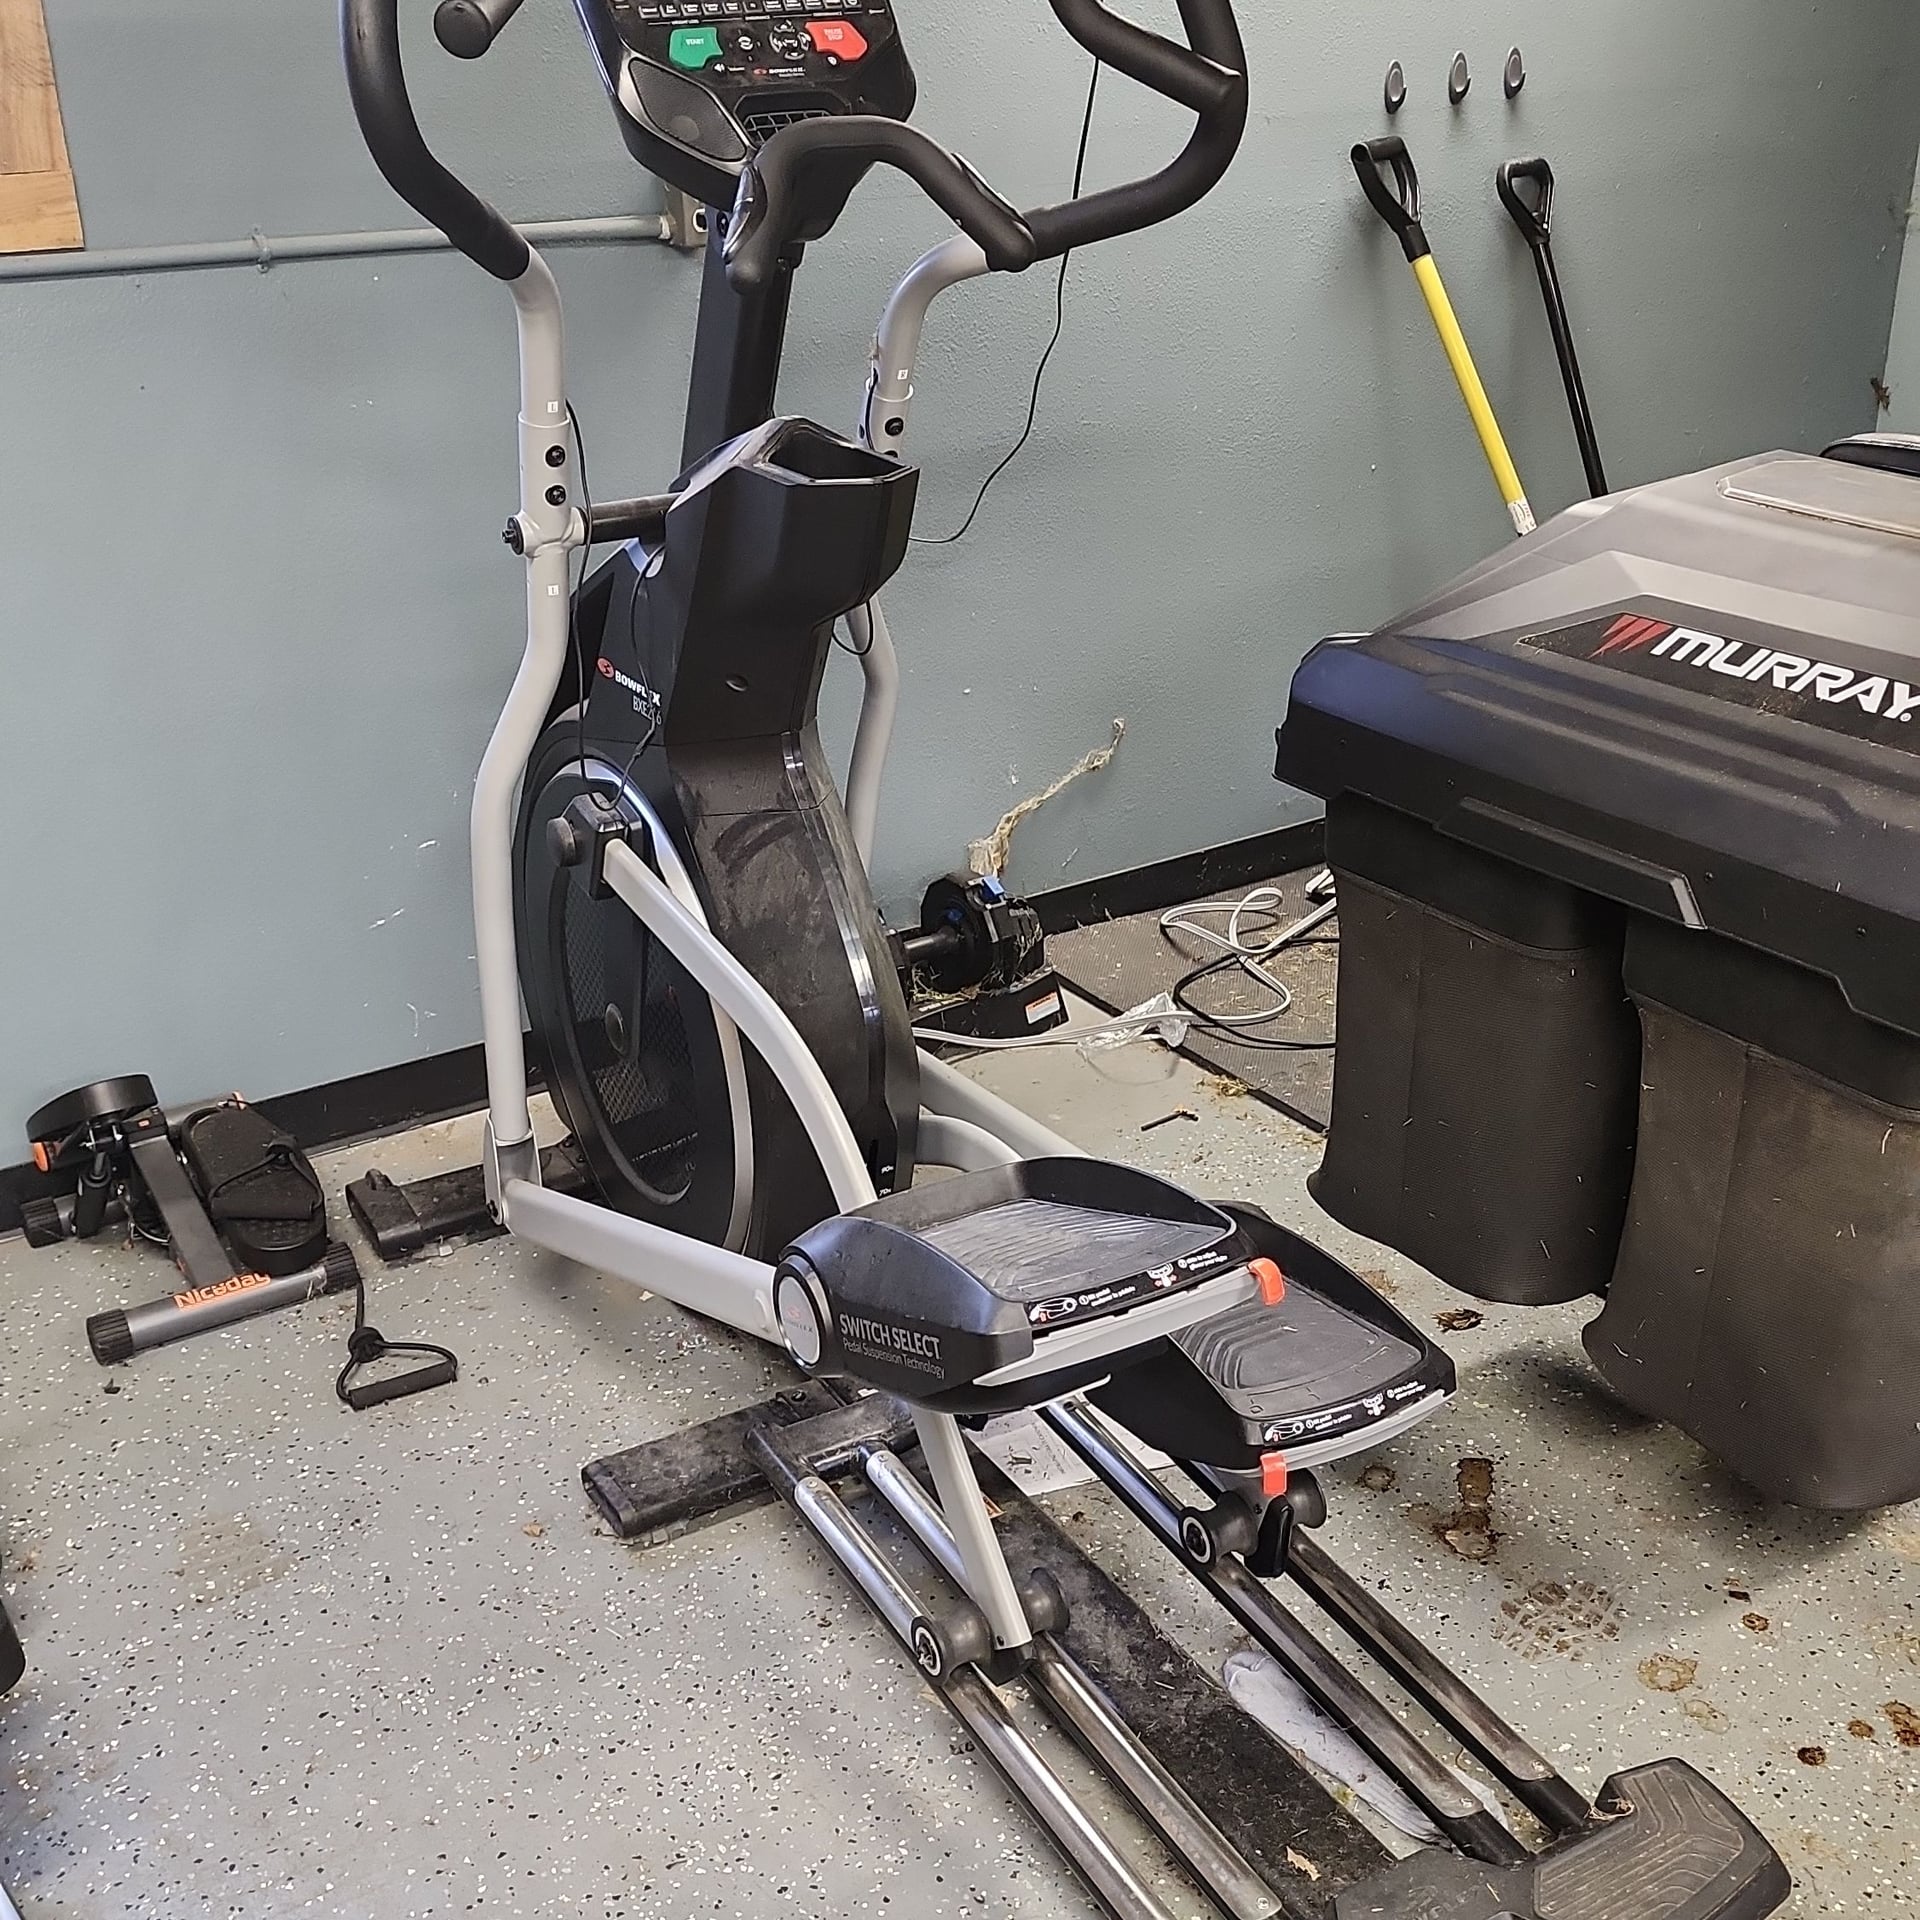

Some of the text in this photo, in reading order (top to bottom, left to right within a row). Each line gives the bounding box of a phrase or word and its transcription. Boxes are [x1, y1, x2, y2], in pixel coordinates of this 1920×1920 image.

[1650, 626, 1920, 720] MURRAY
[173, 1272, 271, 1309] Niceday
[839, 1312, 941, 1360] SWITCH SELECT
[842, 1337, 945, 1380] Pedal Suspension Technology
